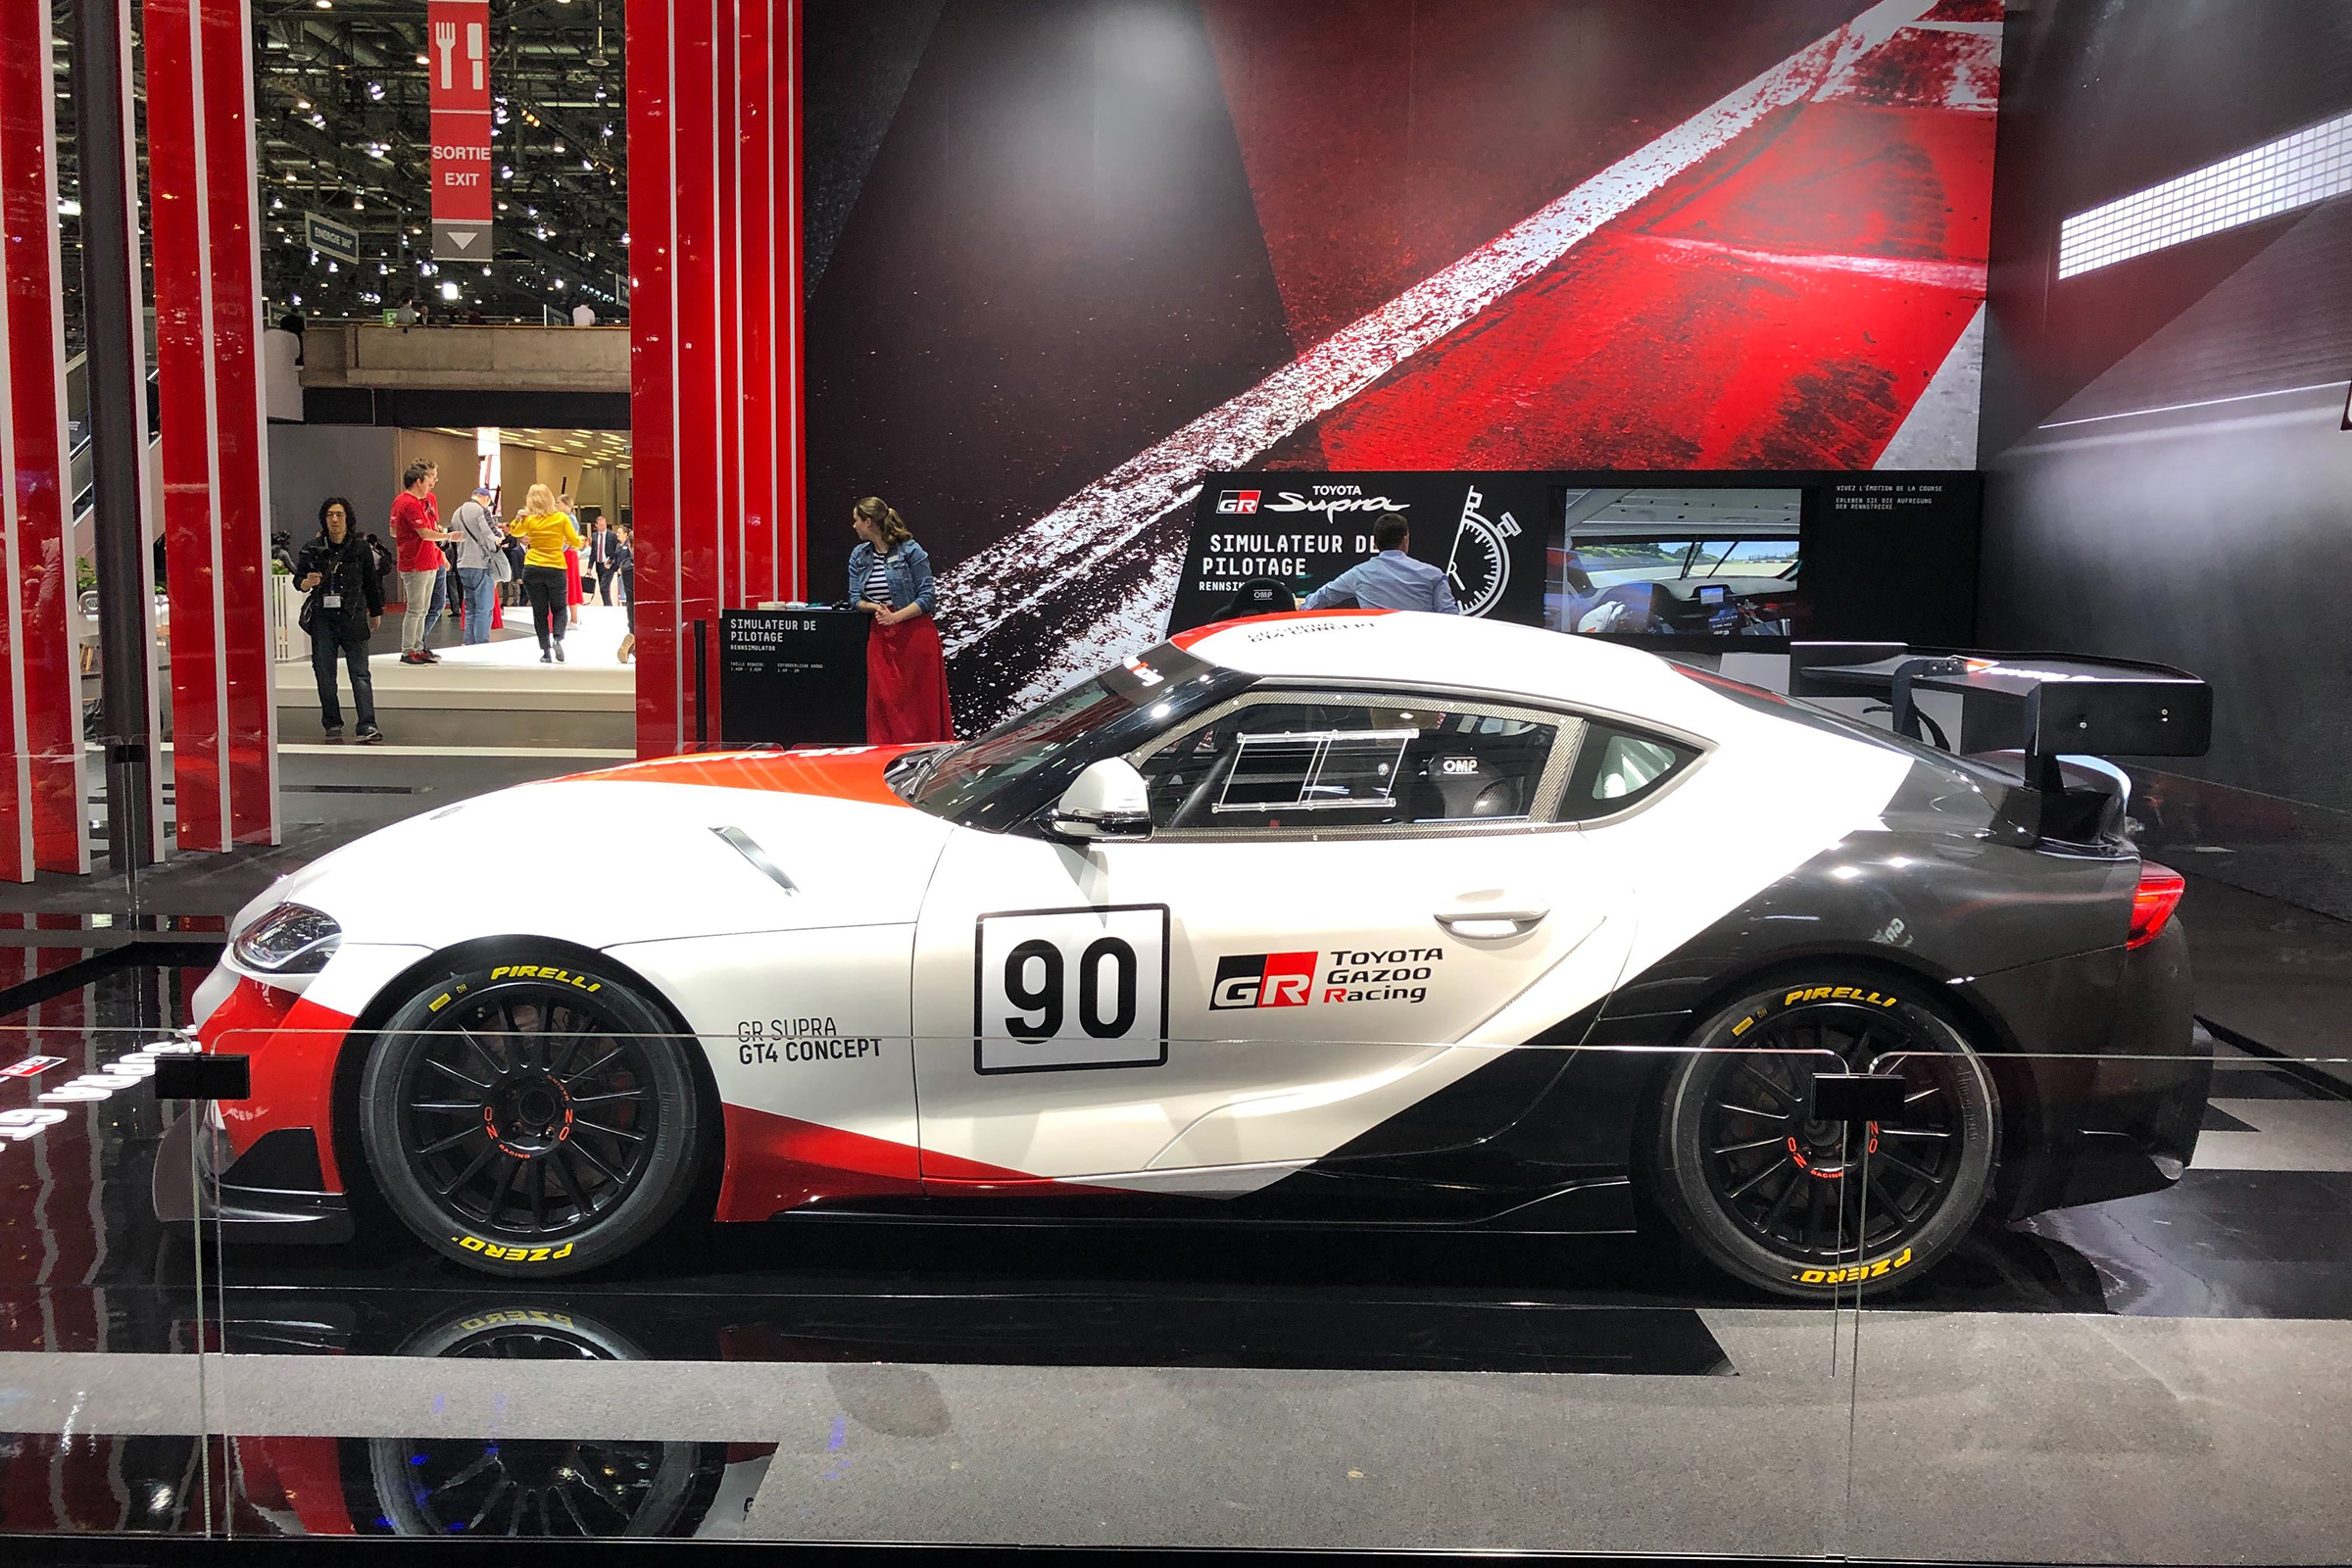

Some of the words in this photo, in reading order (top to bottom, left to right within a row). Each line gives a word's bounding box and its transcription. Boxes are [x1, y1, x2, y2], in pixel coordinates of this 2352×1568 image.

[432, 145, 491, 161] SORTIE
[445, 172, 480, 186] EXIT
[1312, 485, 1362, 496] TOYOTA
[1217, 498, 1257, 514] GR
[1263, 492, 1411, 523] Supra
[1209, 534, 1344, 553] SIMULATEUR
[1202, 558, 1306, 576] PILOTAGE
[730, 618, 799, 630] SIMULATEUR
[804, 620, 816, 631] DE
[730, 631, 784, 643] PILOTAGE
[1443, 759, 1479, 772] OMP
[1330, 947, 1444, 966] TOYOTA
[491, 965, 602, 993] PIRELLI
[1327, 967, 1432, 985] GAZOO
[1004, 936, 1138, 1045] 90
[1212, 972, 1311, 1008] GR
[1323, 984, 1427, 1004] Racing
[1785, 986, 1897, 1008] PIRELLI
[738, 1021, 764, 1044] GR
[770, 1016, 838, 1042] SUPRA
[739, 1043, 779, 1065] GT4
[785, 1038, 882, 1062] CONCEPT
